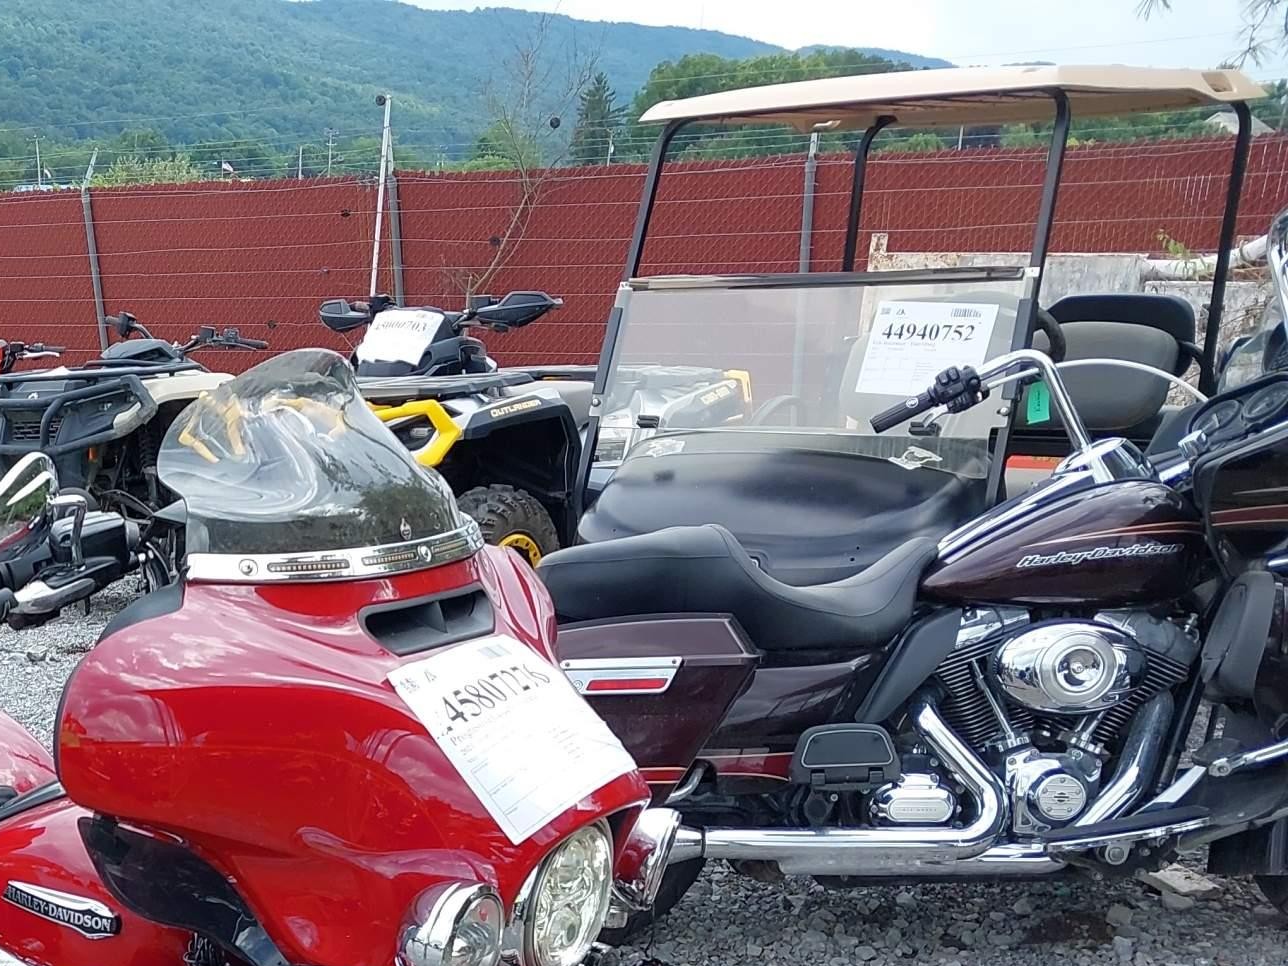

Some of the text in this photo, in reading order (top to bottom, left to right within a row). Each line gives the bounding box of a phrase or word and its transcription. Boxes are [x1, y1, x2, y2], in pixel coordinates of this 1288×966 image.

[881, 322, 975, 342] 44940752
[490, 399, 542, 418] OUTLANDER
[1016, 543, 1184, 568] Harley-Davidson
[442, 663, 551, 722] 45807276
